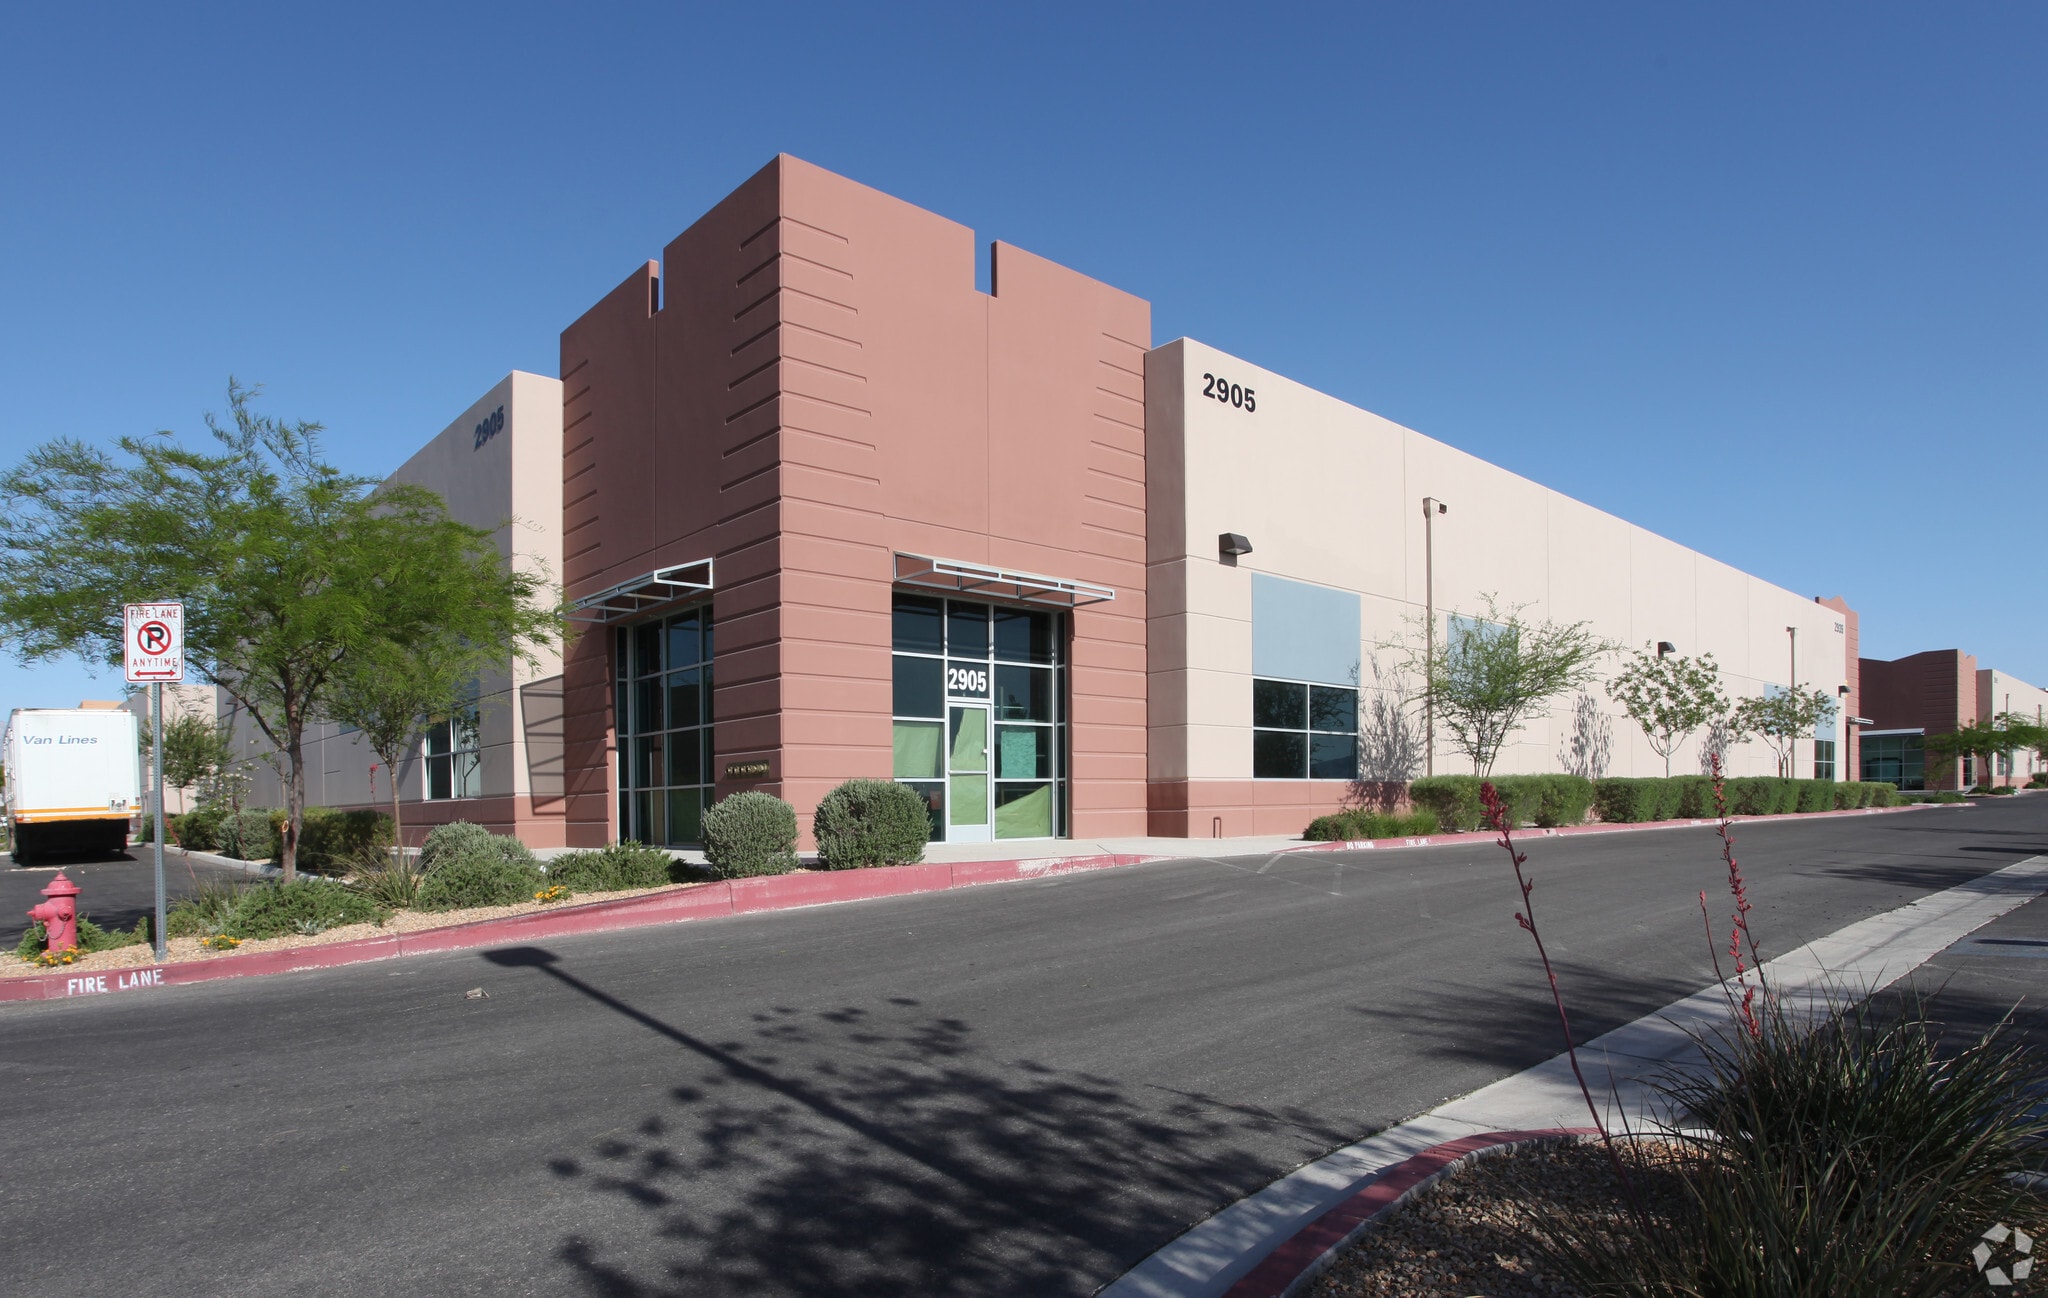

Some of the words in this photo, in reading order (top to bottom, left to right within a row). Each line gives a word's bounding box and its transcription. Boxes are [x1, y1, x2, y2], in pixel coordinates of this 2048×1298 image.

[1203, 373, 1256, 413] 2905
[474, 404, 504, 452] 2905
[130, 609, 151, 619] FIRE
[155, 609, 178, 619] LANE
[132, 657, 178, 667] ANYTIME
[948, 668, 987, 692] 2905
[23, 735, 52, 745] Van
[58, 735, 98, 745] Lines
[67, 976, 108, 996] FIRE
[119, 969, 165, 989] LANE
